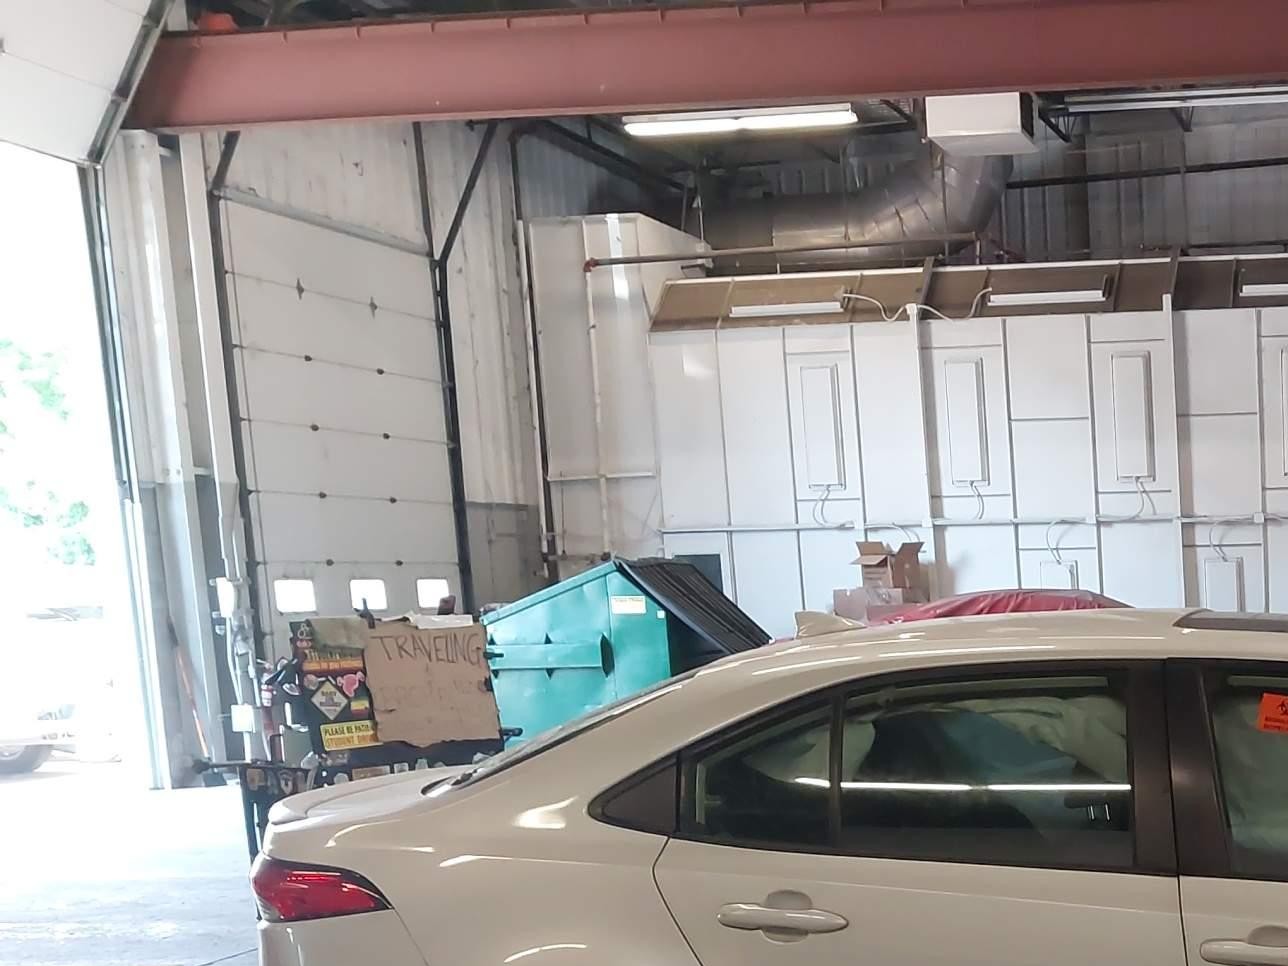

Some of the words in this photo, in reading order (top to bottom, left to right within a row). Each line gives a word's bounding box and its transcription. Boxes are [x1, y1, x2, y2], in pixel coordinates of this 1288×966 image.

[370, 632, 482, 666] TRAVELING
[324, 726, 345, 737] PLEASE
[346, 725, 355, 735] BE
